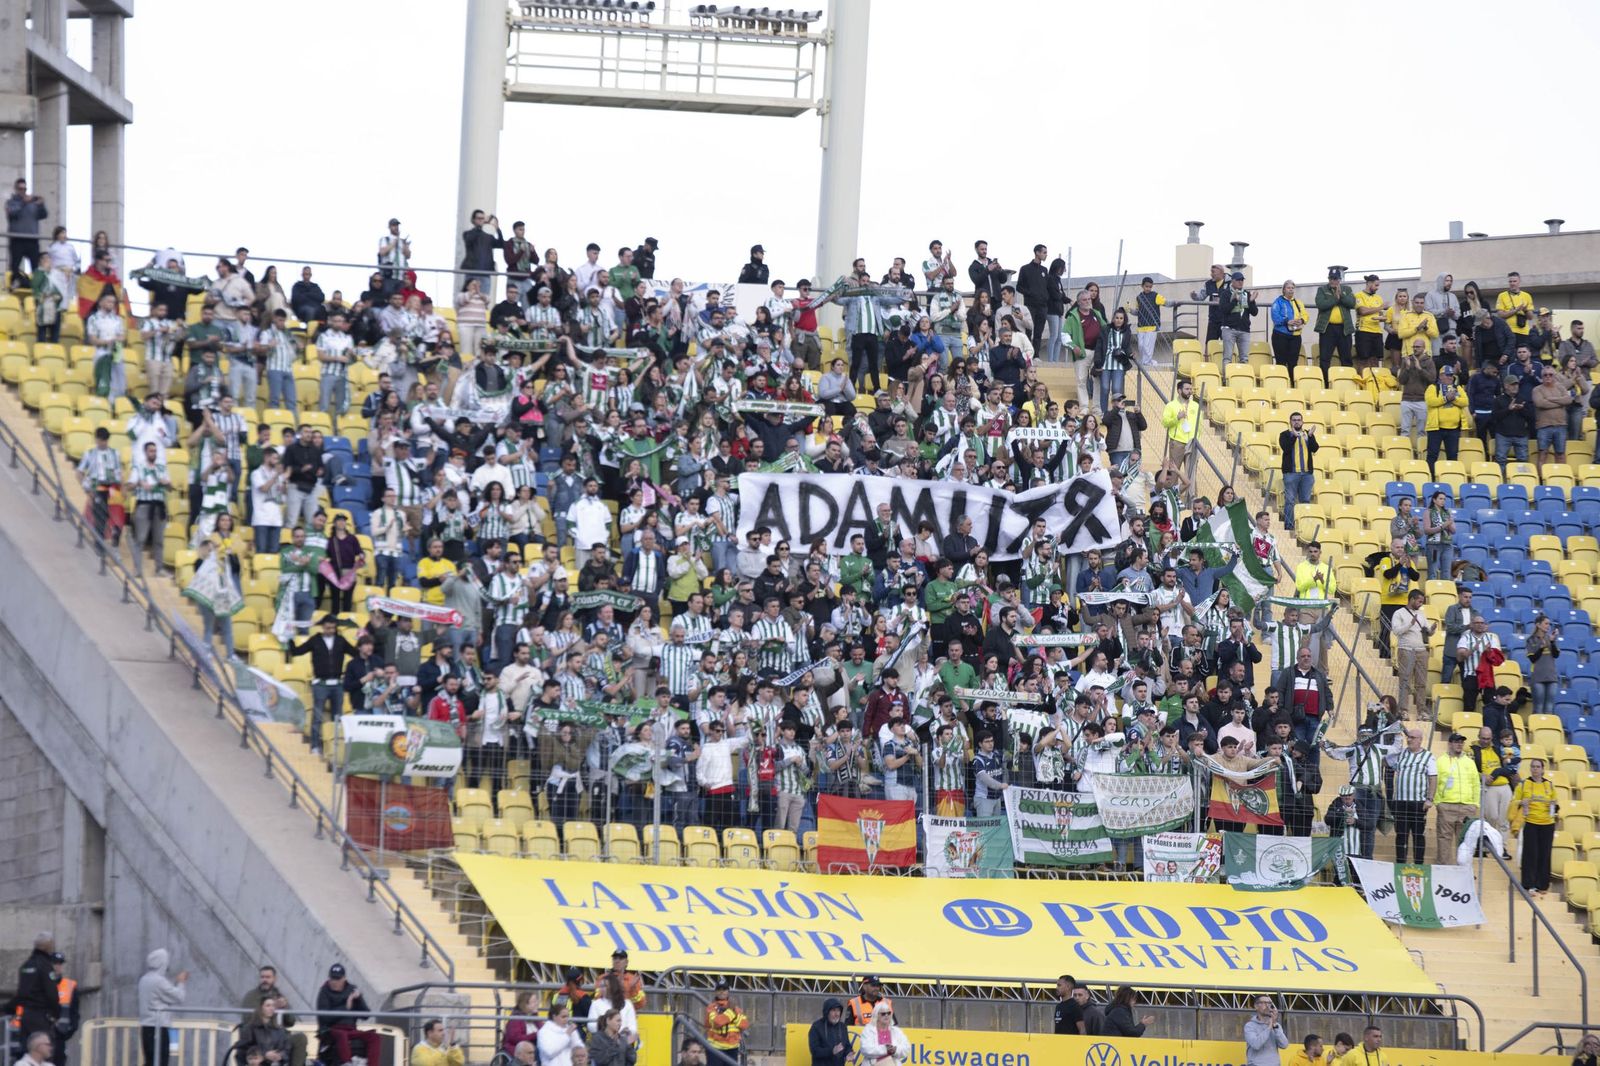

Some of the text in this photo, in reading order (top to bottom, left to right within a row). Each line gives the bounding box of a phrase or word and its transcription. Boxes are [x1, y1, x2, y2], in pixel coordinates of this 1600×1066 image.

[753, 480, 1058, 554] ADAMUZ
[1020, 789, 1082, 804] ESTAMOS
[1019, 802, 1048, 815] CON
[1014, 820, 1067, 835] ADAMUZ
[1052, 839, 1098, 850] HUELVA
[1055, 848, 1080, 858] 1954
[542, 878, 865, 922] LA PASIÓN
[1434, 884, 1471, 904] 1960
[561, 917, 906, 964] PIDE OTRA
[1073, 941, 1359, 973] CERVEZAS
